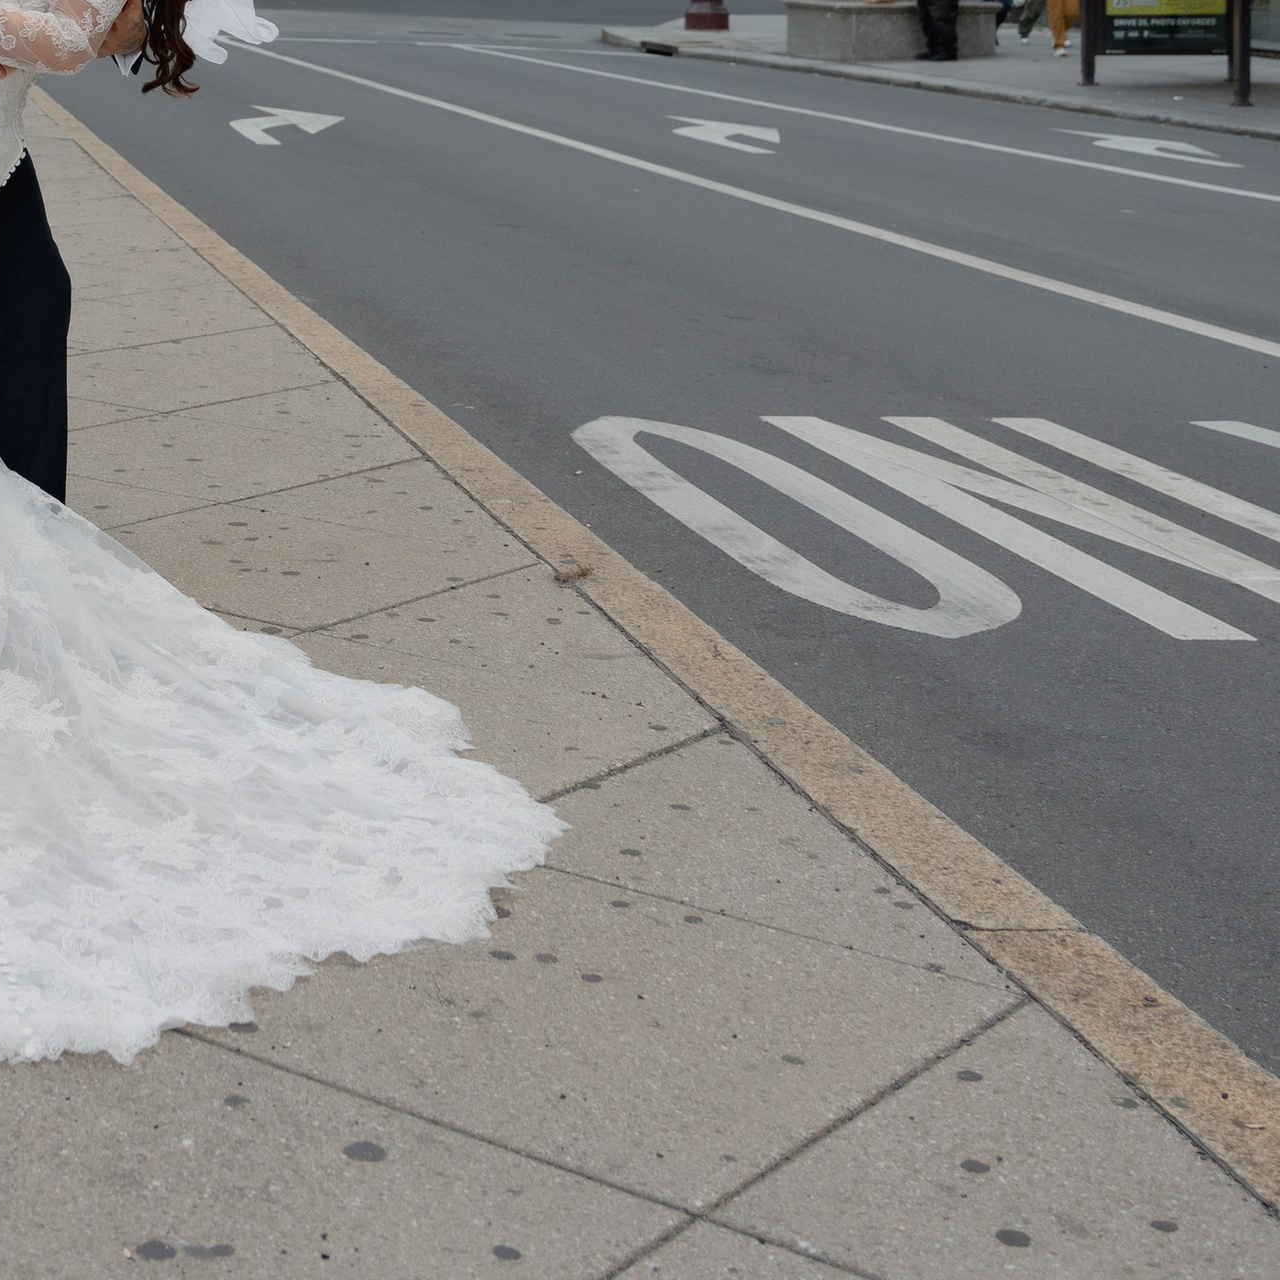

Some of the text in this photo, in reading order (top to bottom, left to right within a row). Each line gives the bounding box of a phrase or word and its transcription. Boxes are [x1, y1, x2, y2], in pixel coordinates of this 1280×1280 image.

[1113, 17, 1136, 27] DRIVE
[1150, 17, 1176, 27] PHOTO
[1177, 17, 1217, 26] ENFORCED
